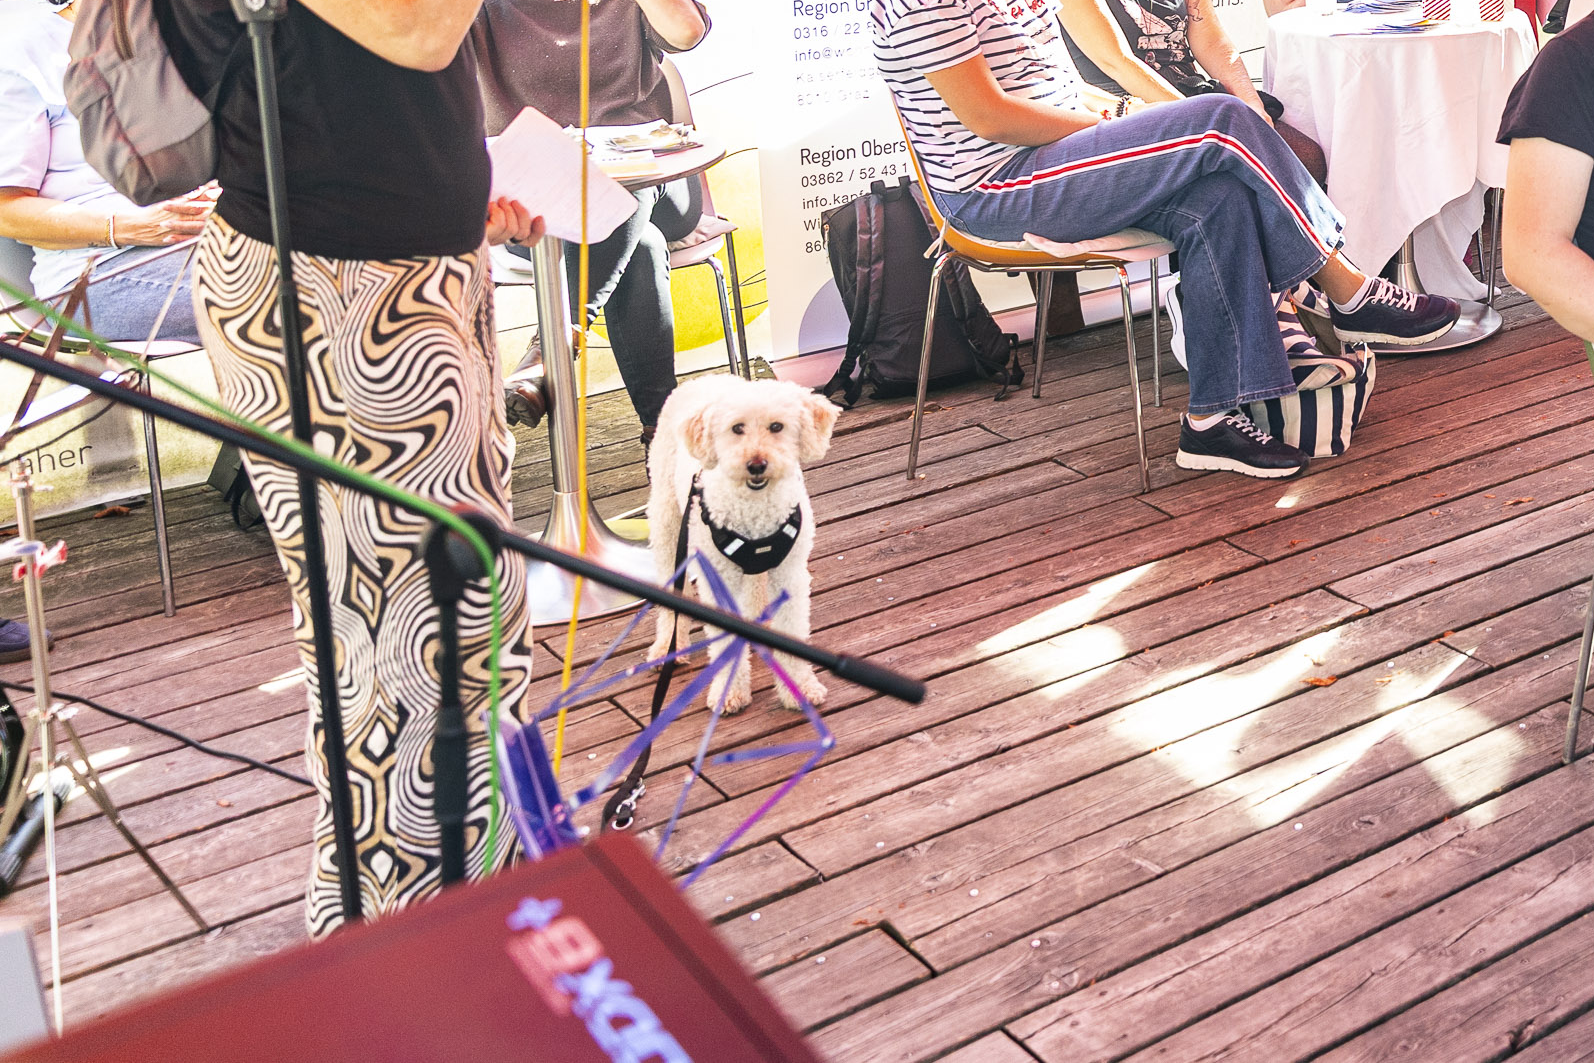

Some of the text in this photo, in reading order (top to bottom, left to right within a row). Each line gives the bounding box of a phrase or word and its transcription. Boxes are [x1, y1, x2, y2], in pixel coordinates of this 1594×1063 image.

[794, 25, 828, 39] 0316
[800, 145, 856, 167] Region
[801, 163, 908, 188] 03862 / 52 43 1
